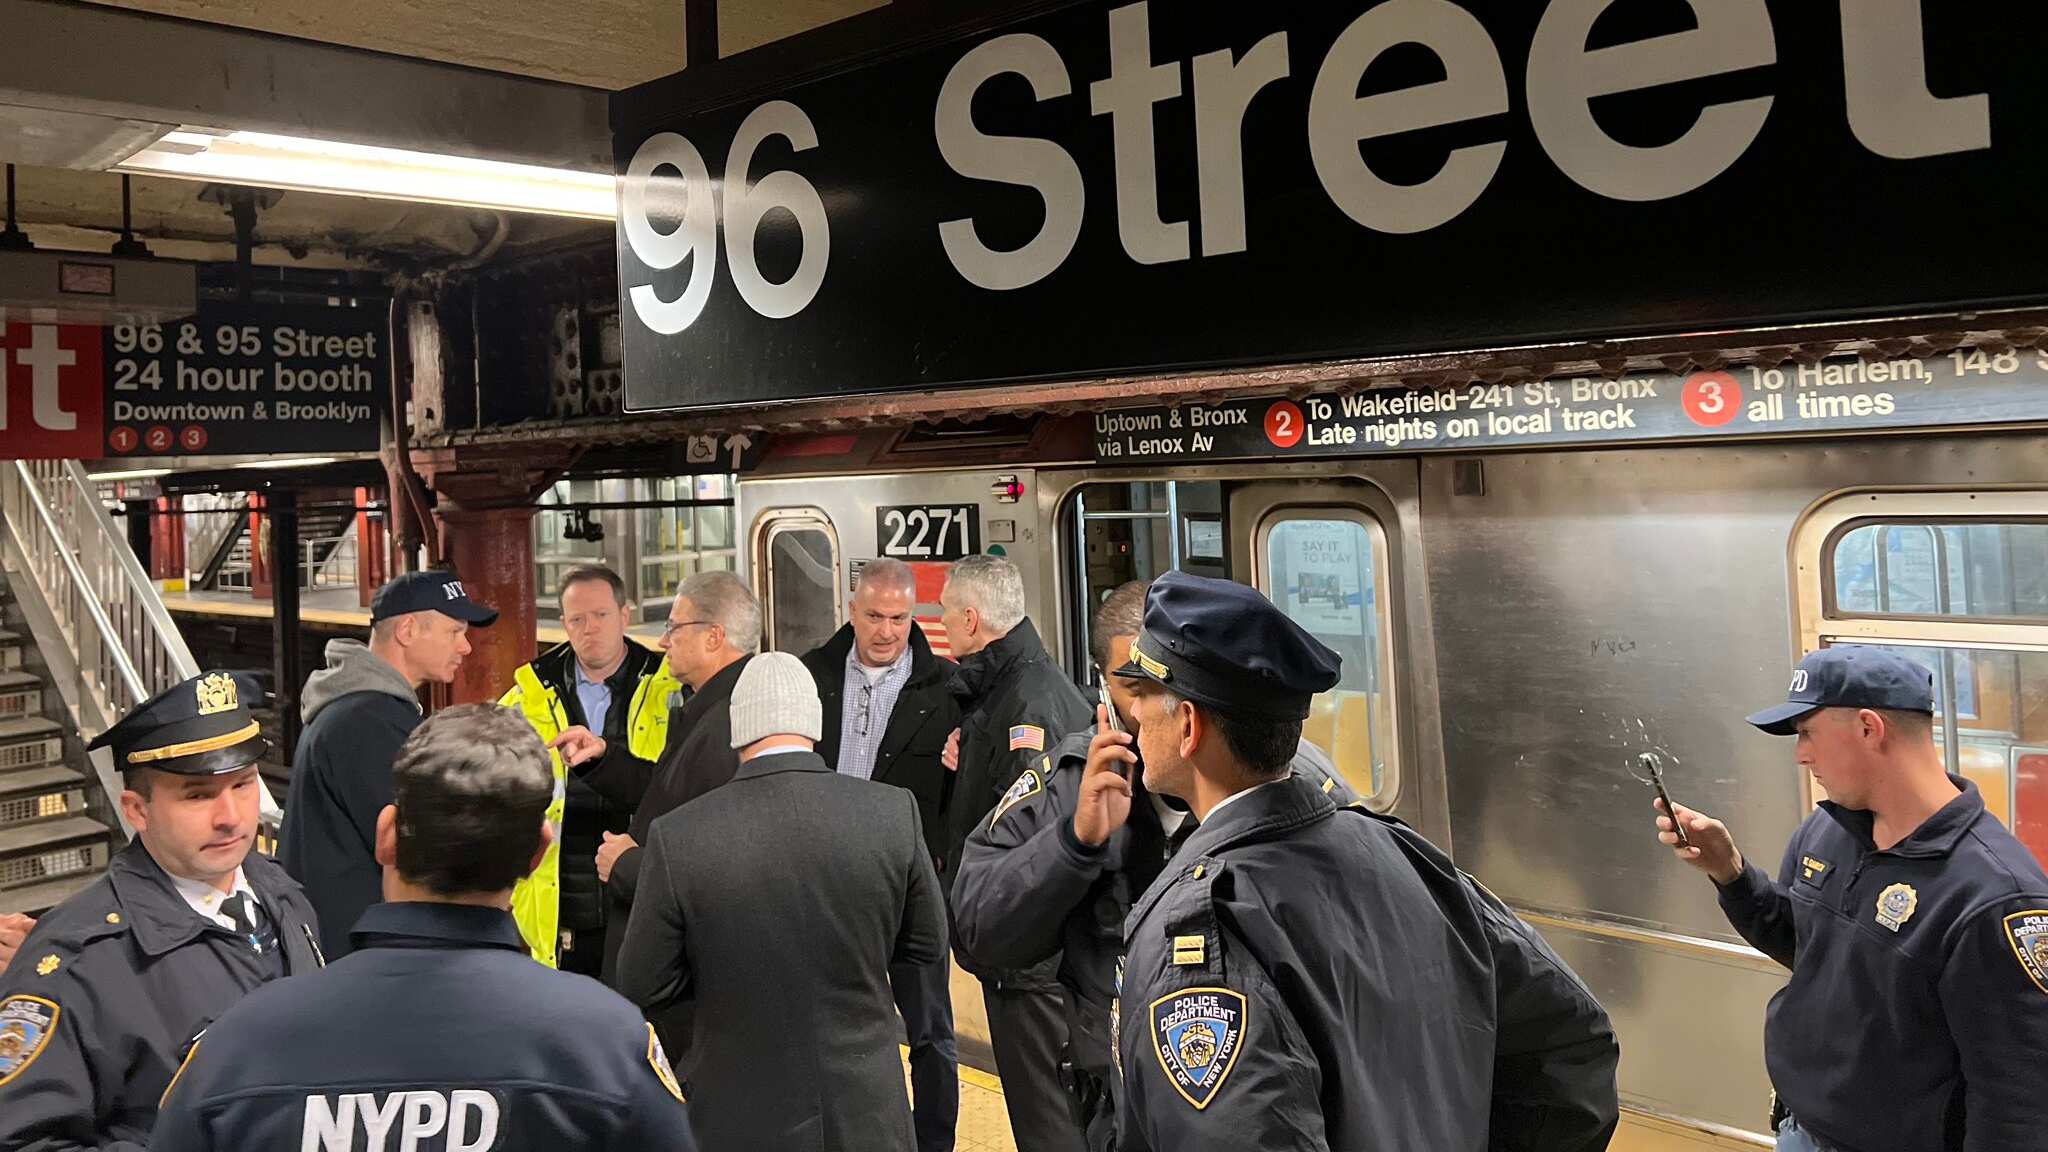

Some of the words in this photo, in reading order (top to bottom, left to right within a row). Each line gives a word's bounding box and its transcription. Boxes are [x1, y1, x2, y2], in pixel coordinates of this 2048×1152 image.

[623, 100, 831, 335] 96
[114, 323, 164, 353] 96
[176, 323, 204, 354] &
[216, 325, 262, 356] 95
[273, 326, 377, 358] Street
[114, 359, 163, 390] 24
[176, 360, 264, 391] hour
[274, 361, 372, 392] booth
[1797, 354, 1933, 387] Harlem,
[1947, 346, 2020, 377] 148
[114, 401, 245, 421] Downtown
[252, 401, 268, 420] &
[275, 400, 371, 423] Brooklyn
[1306, 399, 1332, 421] To
[1341, 382, 1514, 418] Wakefield-241
[1523, 381, 1561, 408] St,
[1571, 377, 1657, 402] Bronx
[1747, 396, 1784, 422] all
[1796, 392, 1895, 419] times
[1095, 412, 1162, 436] Uptown
[1169, 408, 1182, 428] &
[1190, 406, 1248, 427] Bronx
[1307, 421, 1357, 446] Late
[1365, 418, 1438, 446] nights
[1446, 417, 1479, 439] on
[1488, 407, 1551, 435] local
[1562, 403, 1636, 431] track
[1098, 437, 1122, 457] via
[1128, 435, 1184, 456] Lenox
[1191, 432, 1214, 453] Av
[884, 508, 970, 556] 2271
[1789, 669, 1808, 692] PD
[2018, 947, 2034, 968] CITY
[1160, 1006, 1236, 1032] DEPARTMENT
[1174, 995, 1218, 1012] POLICE
[1161, 1043, 1179, 1071] CITY
[1175, 1069, 1190, 1087] OF
[1204, 1063, 1223, 1089] NEW
[1218, 1029, 1238, 1060] YORK
[301, 1089, 500, 1152] NYPD
